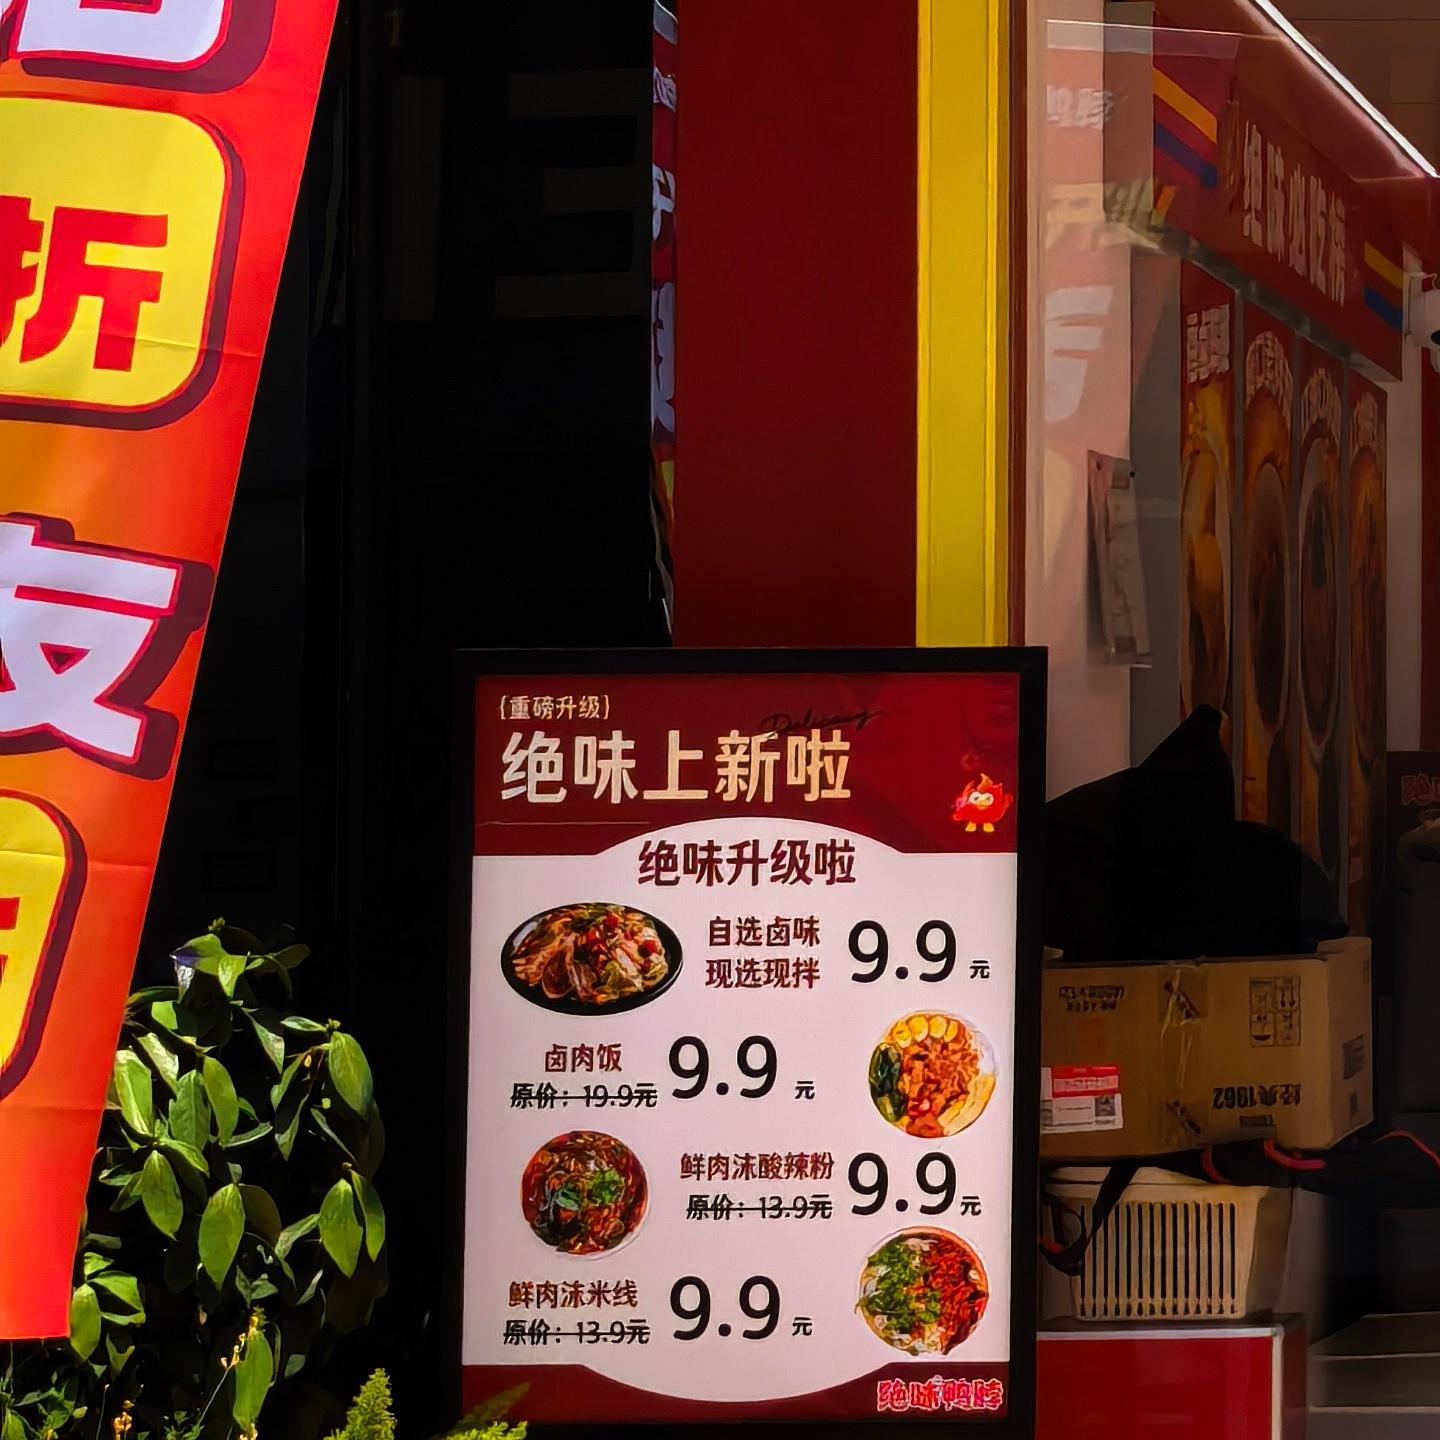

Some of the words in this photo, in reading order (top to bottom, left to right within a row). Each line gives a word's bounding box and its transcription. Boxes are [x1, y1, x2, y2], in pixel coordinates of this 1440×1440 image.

[501, 729, 852, 804] 绝味上新啦
[638, 838, 857, 887] 绝味升级啦
[705, 958, 820, 988] 现选现拌
[707, 916, 820, 948] 自选卤味
[848, 919, 957, 984] 9.9
[969, 960, 991, 979] 元
[544, 1043, 622, 1073] 卤肉饭
[668, 1035, 777, 1100] 9.9
[795, 1081, 815, 1100] 元
[848, 1152, 957, 1216] 9.9
[960, 1195, 982, 1216] 元
[670, 1276, 780, 1341] 9.9
[792, 1317, 813, 1337] 元
[877, 1378, 1003, 1412] 绝味鸭脖
